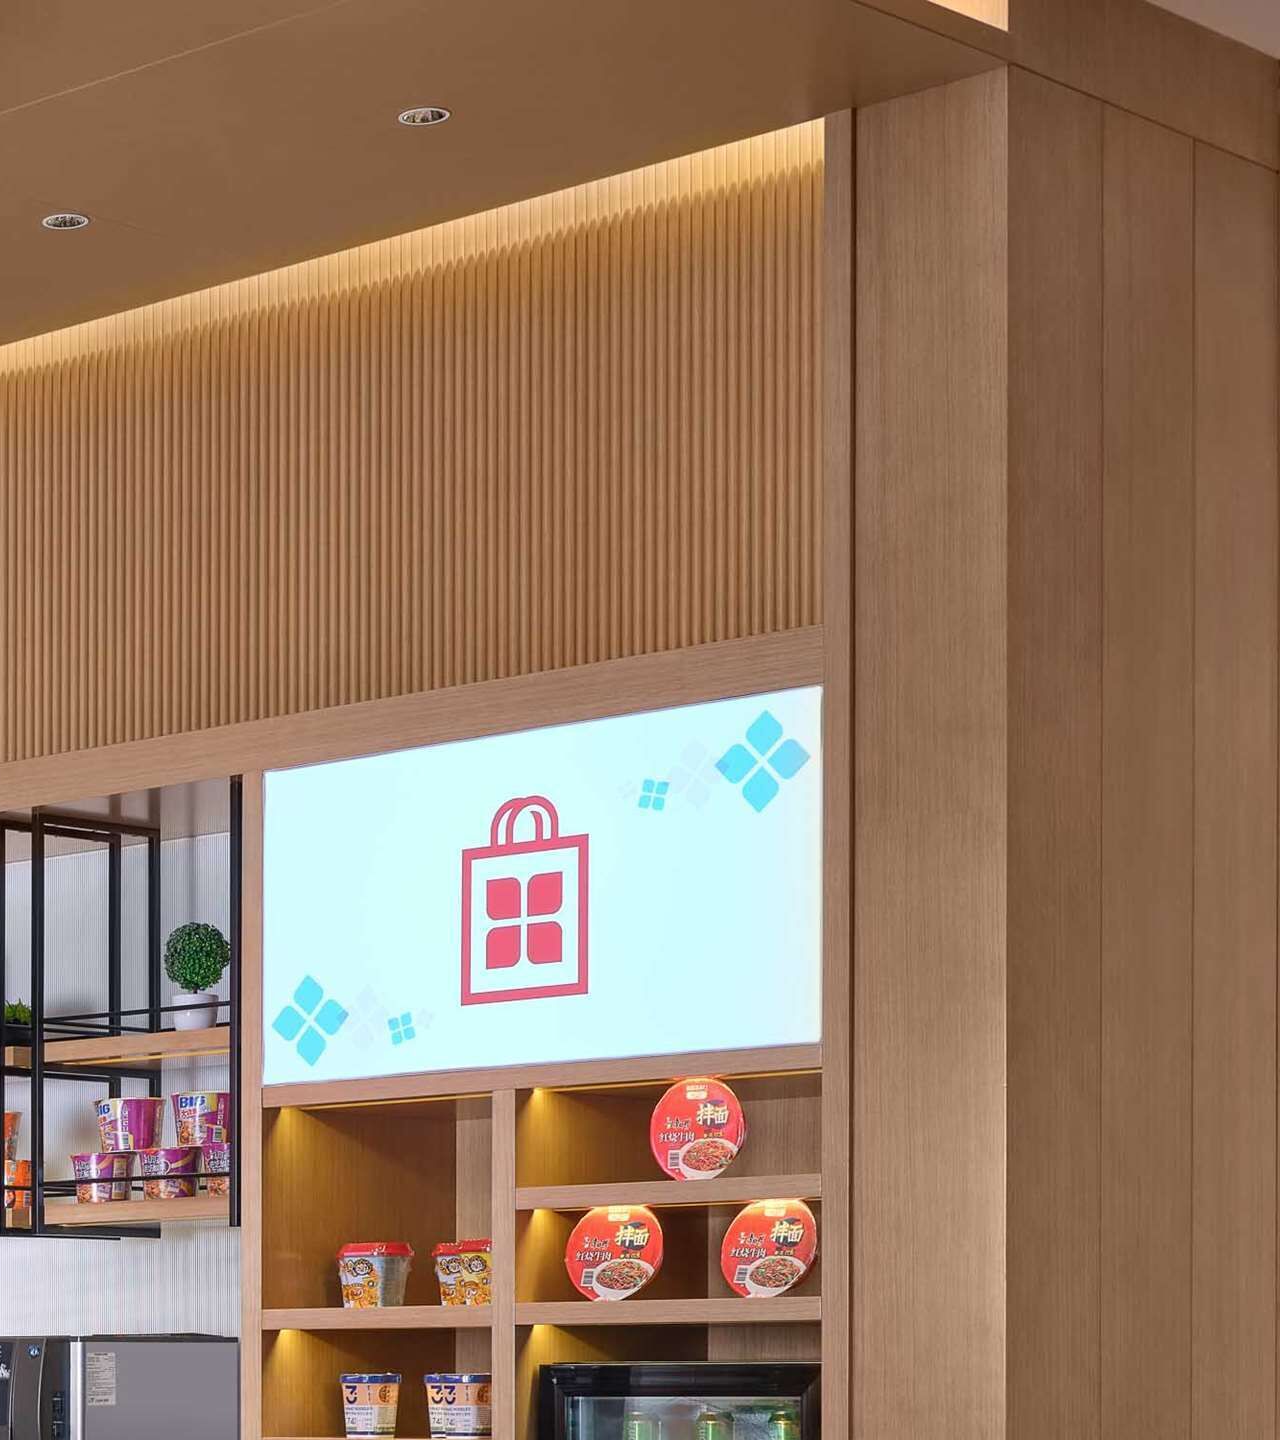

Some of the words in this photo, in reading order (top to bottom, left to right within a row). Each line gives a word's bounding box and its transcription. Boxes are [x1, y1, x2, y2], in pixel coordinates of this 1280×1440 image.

[180, 1096, 206, 1108] BIG
[696, 1103, 729, 1126] 拌面
[614, 1225, 650, 1247] 拌面
[770, 1220, 805, 1242] 拌面
